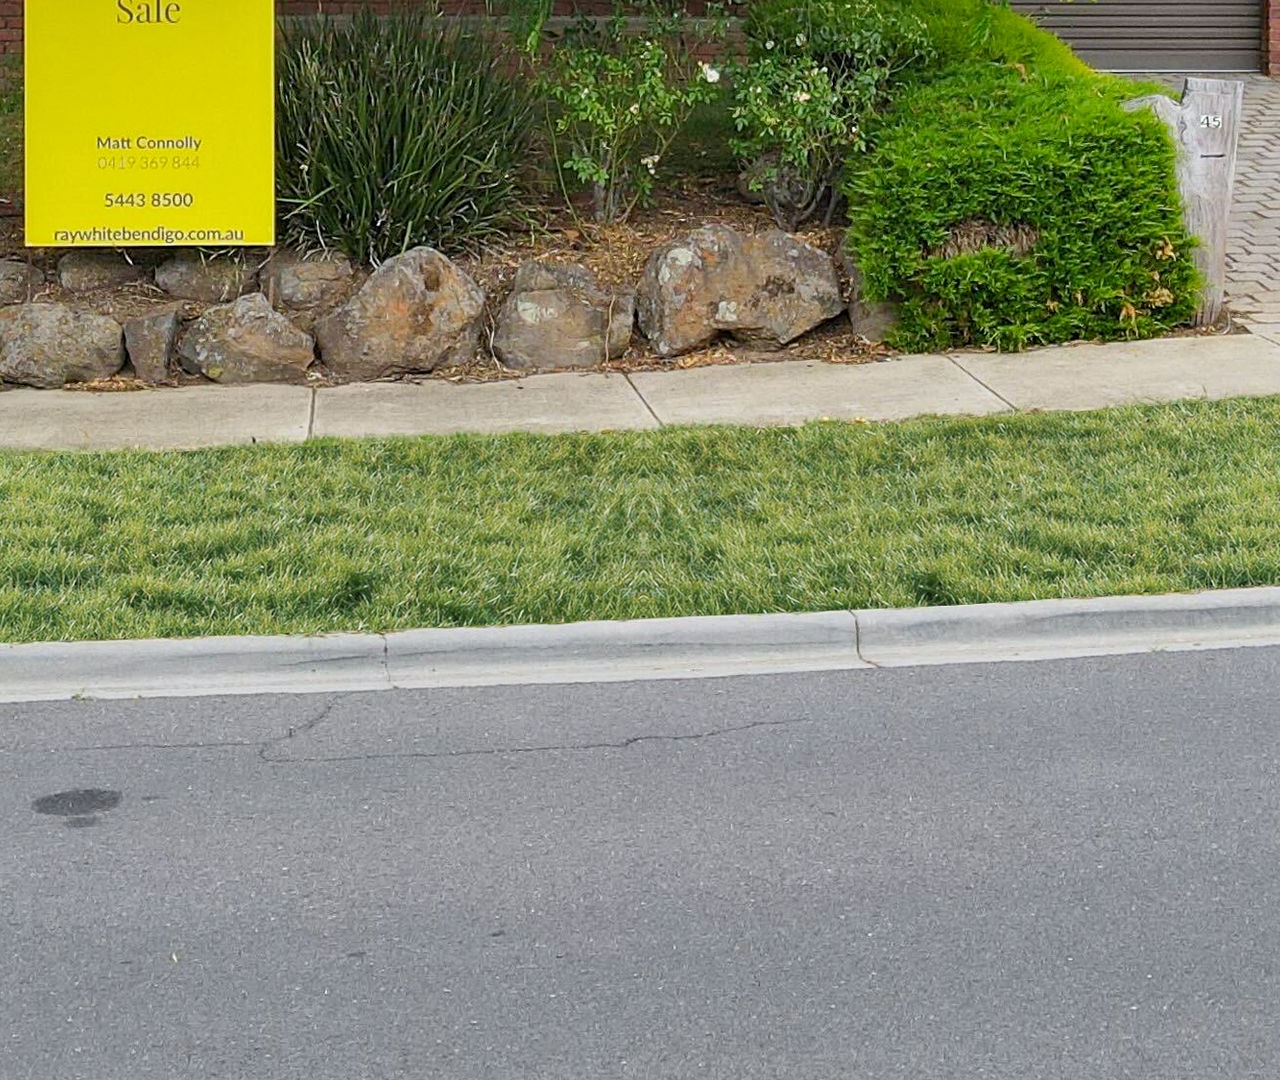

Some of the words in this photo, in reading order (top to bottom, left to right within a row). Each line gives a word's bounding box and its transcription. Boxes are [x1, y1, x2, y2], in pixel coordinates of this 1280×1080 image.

[1200, 115, 1221, 128] 45
[96, 136, 131, 150] Matt
[136, 135, 202, 151] Connolly
[97, 155, 136, 170] 0419
[140, 155, 169, 170] 369
[172, 155, 200, 170] 844
[104, 193, 146, 207] 5443
[151, 193, 193, 207] 8500
[54, 226, 244, 244] raywhitebendigo.com.au
